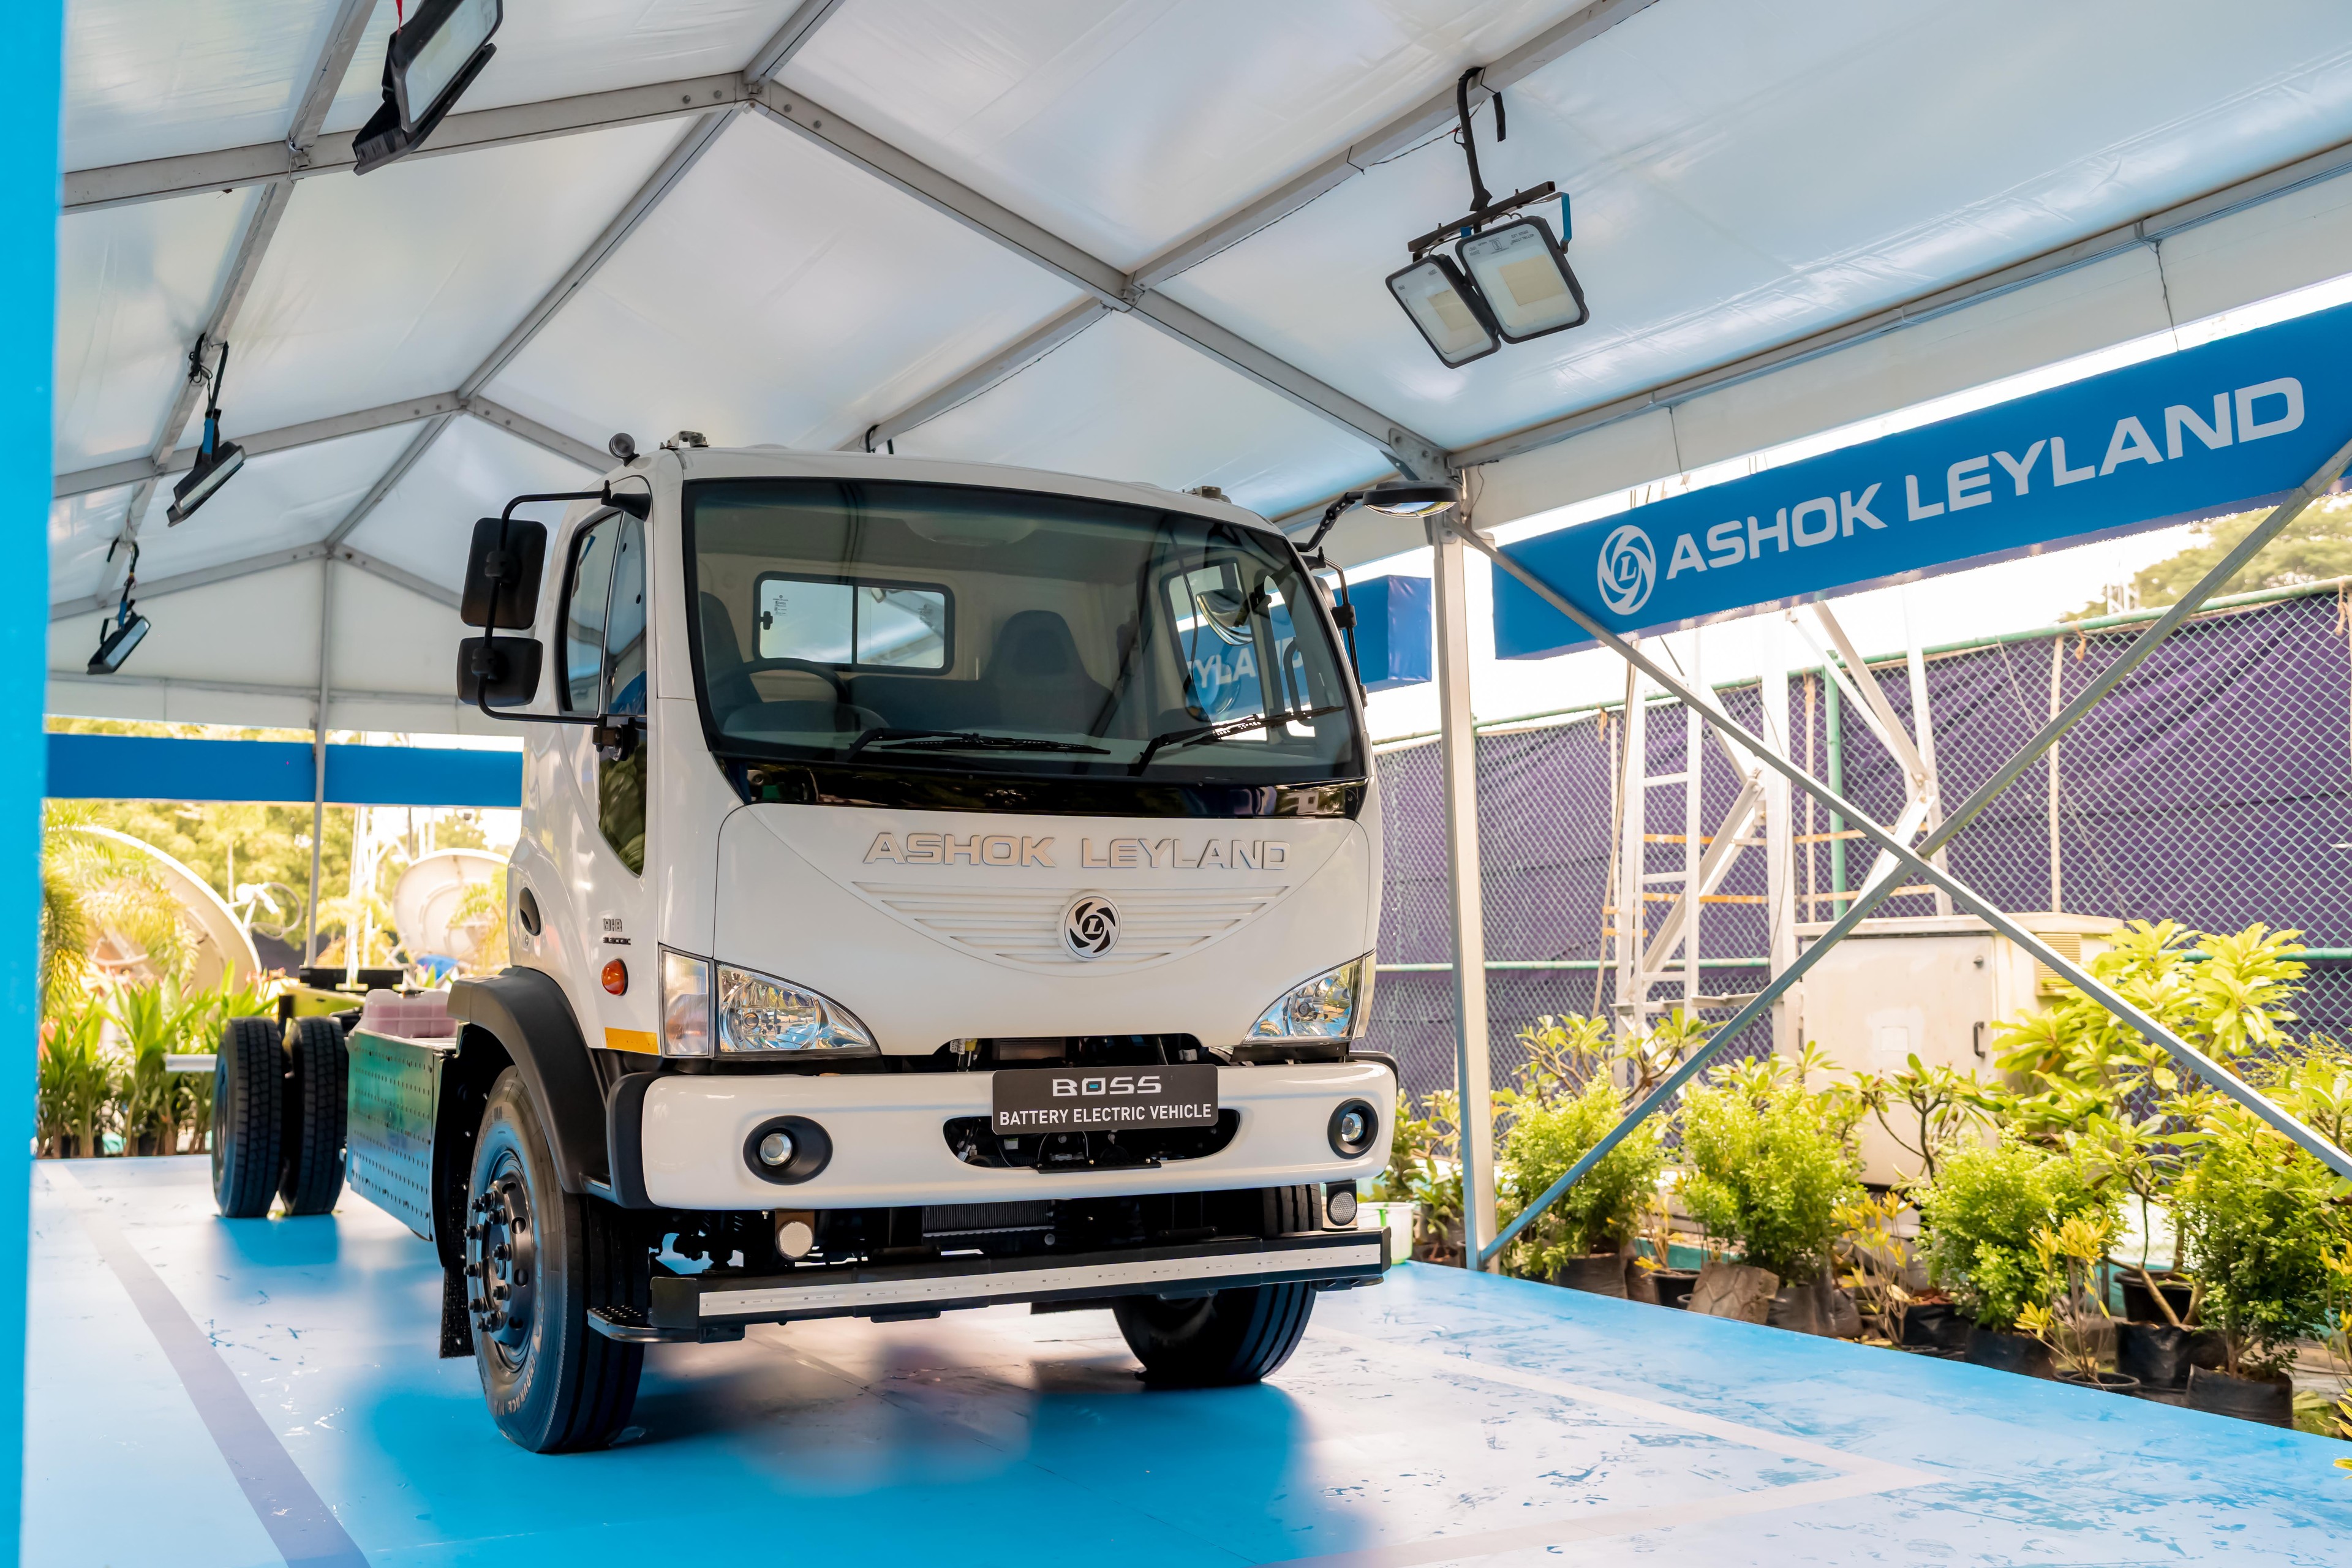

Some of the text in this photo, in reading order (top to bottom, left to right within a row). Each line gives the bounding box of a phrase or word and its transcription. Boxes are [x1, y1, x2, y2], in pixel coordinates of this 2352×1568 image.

[1667, 483, 1888, 580] ASHOK
[1906, 377, 2305, 521] LEYLAND
[862, 832, 1291, 870] ASHOK LEYLAND
[1052, 1076, 1162, 1097] BOSS
[1000, 1103, 1212, 1126] BATTERY ELECTRIC VEHICLE
